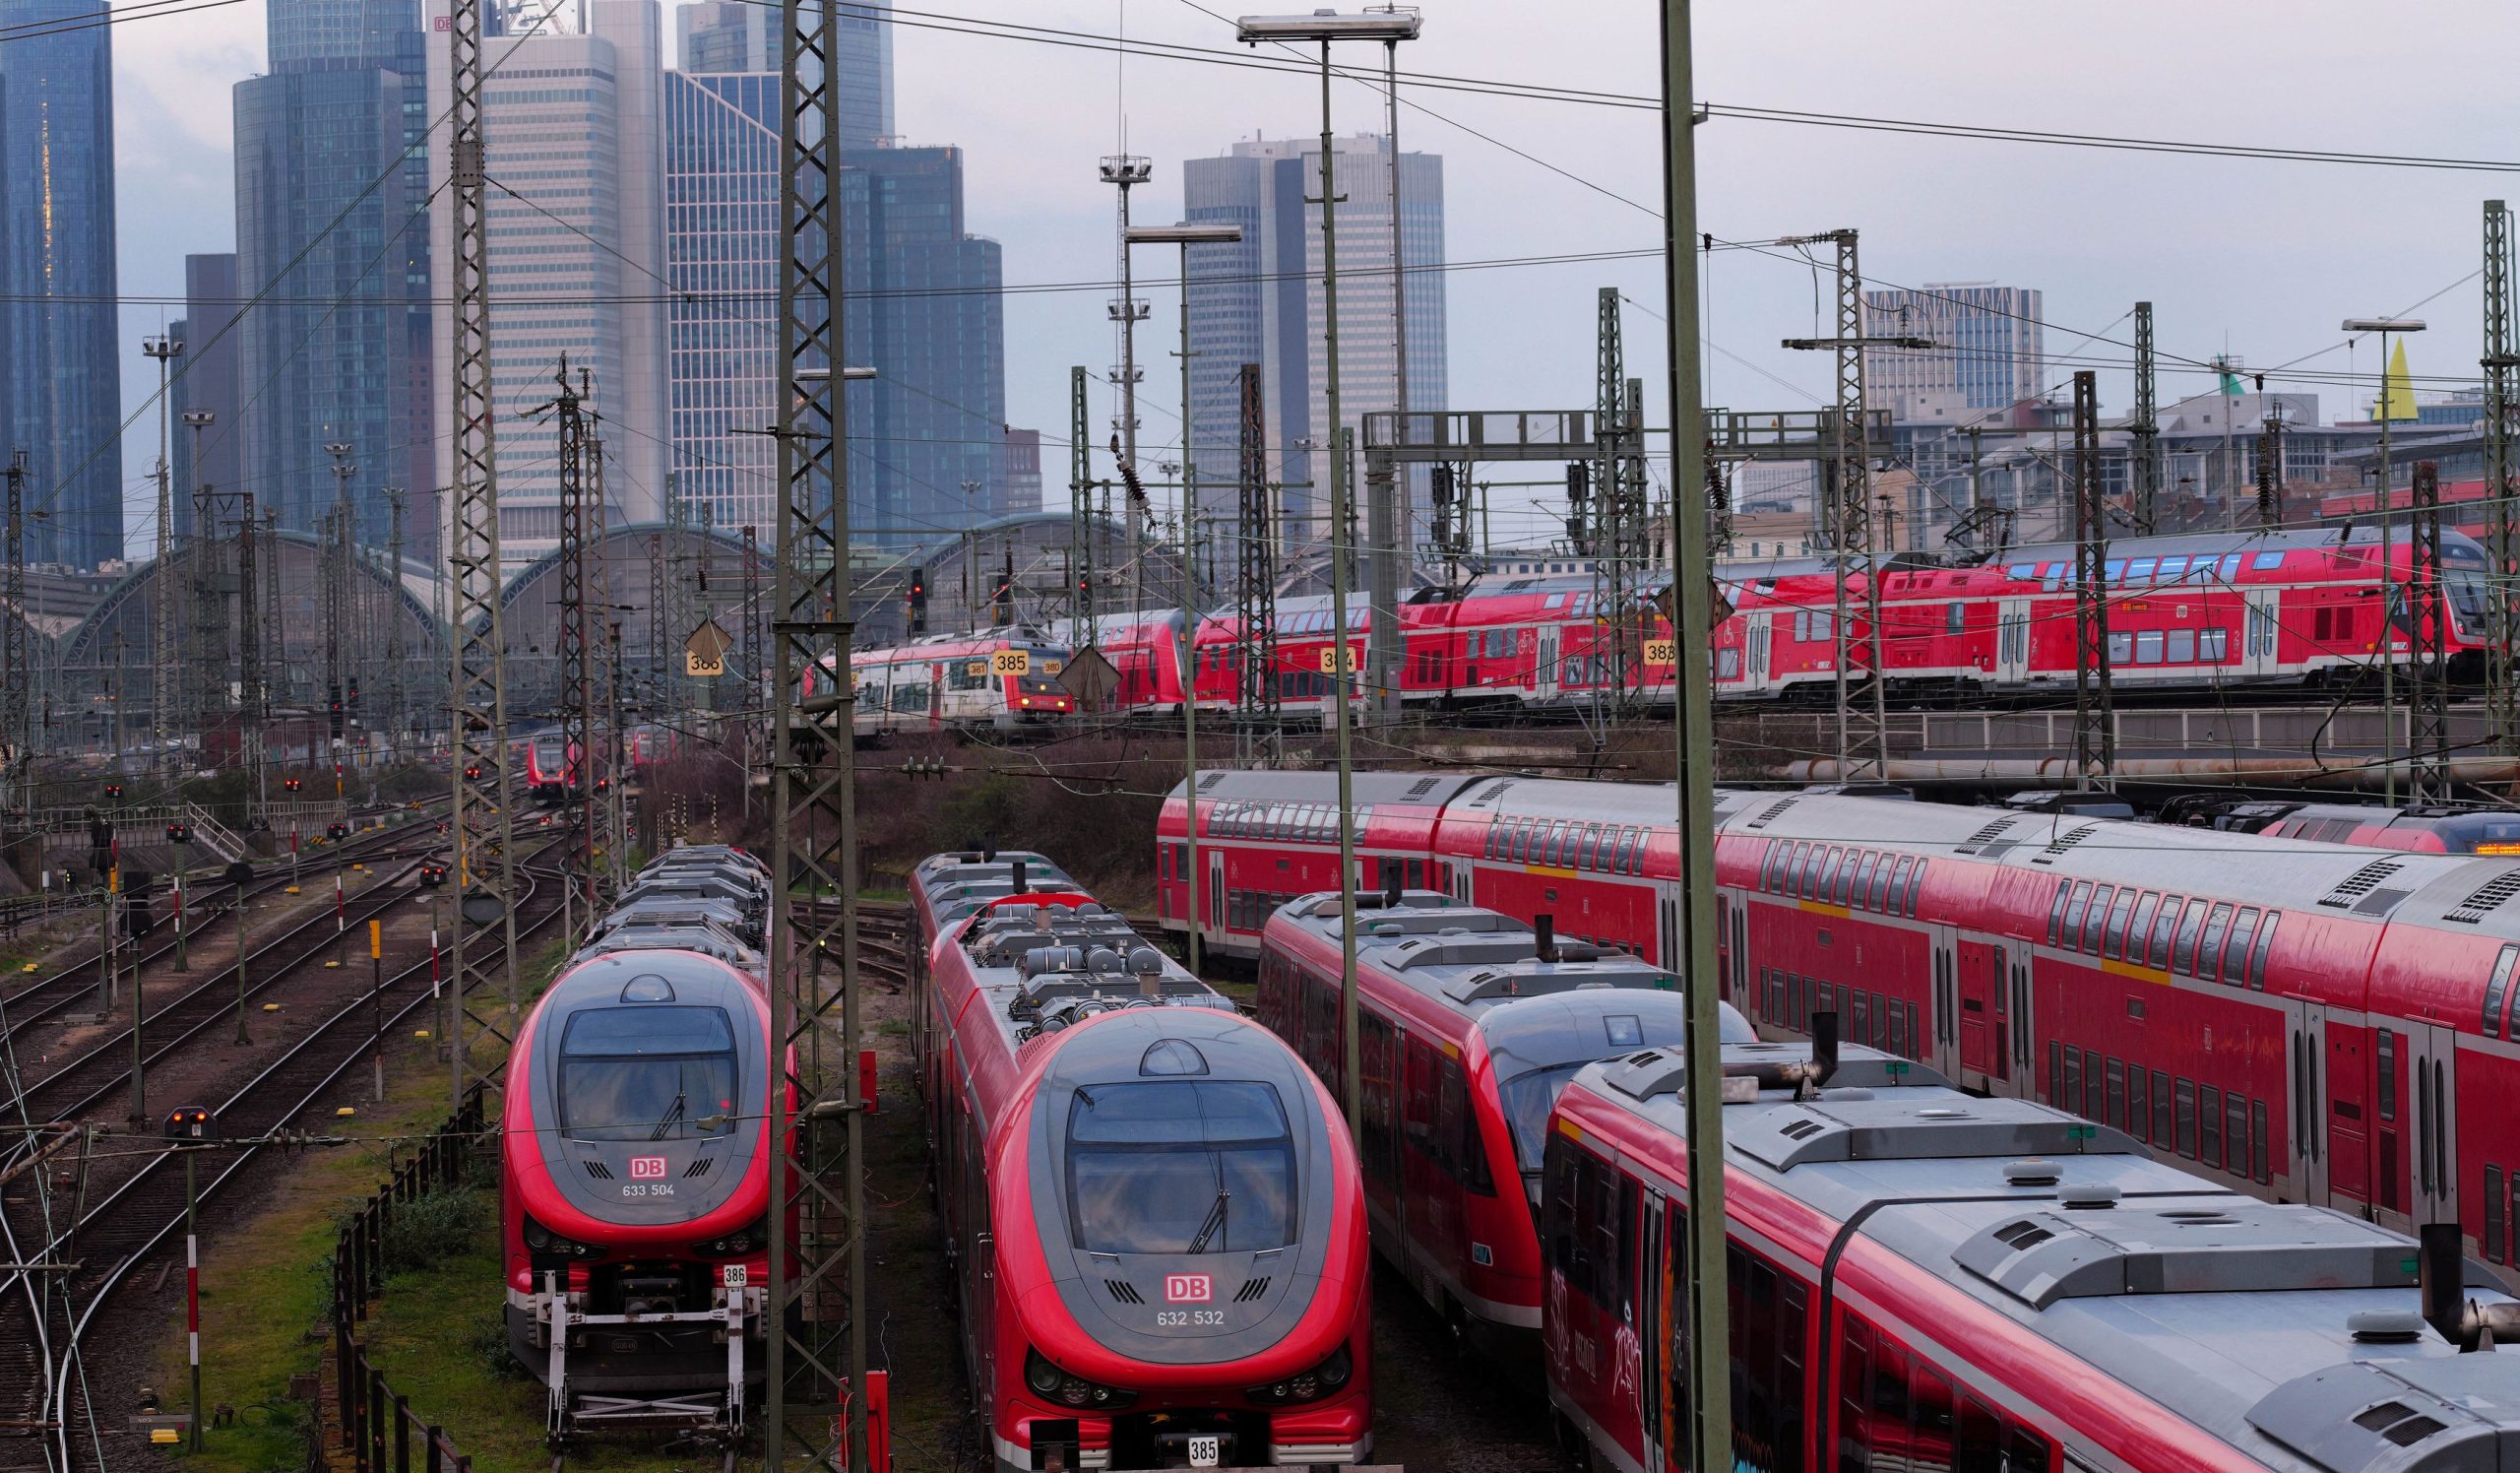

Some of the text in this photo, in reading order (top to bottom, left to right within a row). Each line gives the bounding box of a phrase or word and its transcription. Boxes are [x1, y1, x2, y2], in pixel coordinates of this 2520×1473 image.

[436, 18, 452, 31] DB
[997, 655, 1026, 671] 385
[1324, 653, 1354, 668] 34
[632, 1158, 665, 1177] DB
[622, 1185, 674, 1196] 633 504
[725, 1267, 745, 1282] 386
[1167, 1276, 1210, 1300] DB
[1157, 1311, 1225, 1326] 632 532
[1191, 1441, 1217, 1460] 385
